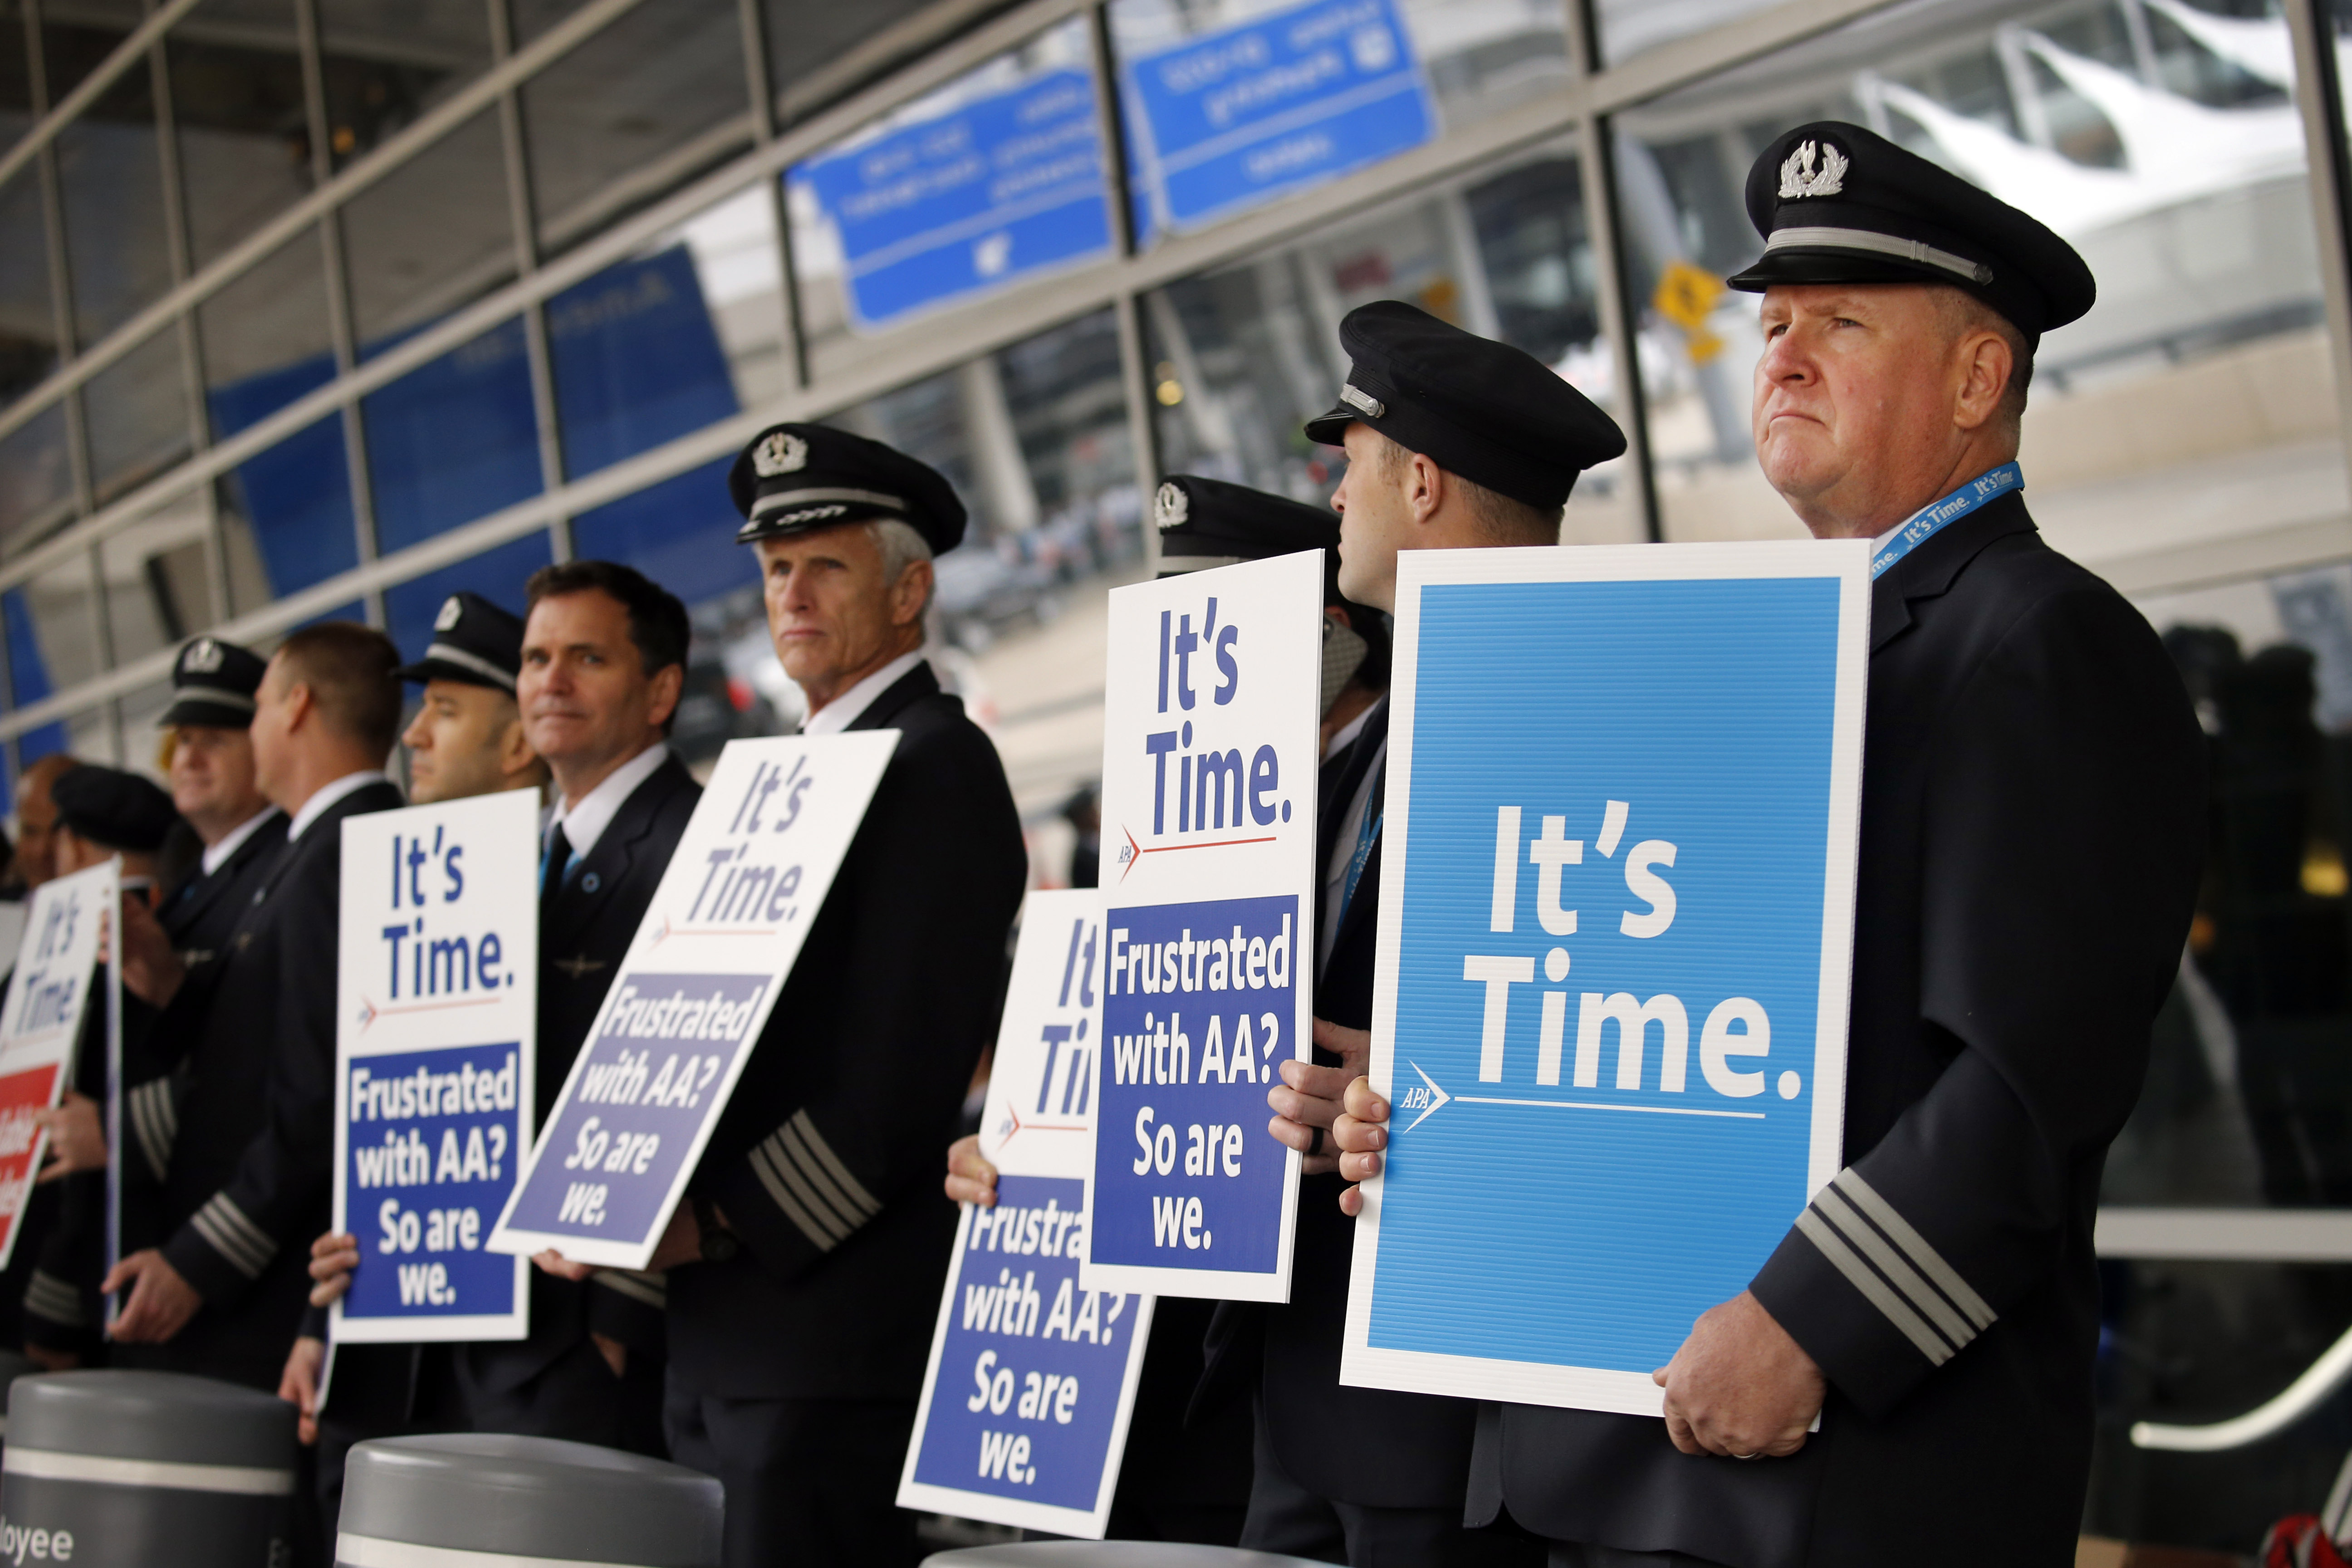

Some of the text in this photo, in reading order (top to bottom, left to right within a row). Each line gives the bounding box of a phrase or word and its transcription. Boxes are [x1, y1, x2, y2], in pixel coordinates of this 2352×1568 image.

[1973, 476, 1998, 495] It's
[1903, 497, 1970, 543] It's Time.
[1873, 552, 1899, 573] me.
[1157, 597, 1239, 713] It's
[729, 754, 814, 834] It's
[1146, 720, 1292, 835] Time.
[392, 825, 464, 909] It's
[686, 841, 803, 922] Time.
[1117, 845, 1132, 863] APA
[1490, 799, 1678, 938] It's
[382, 917, 514, 1000] Time.
[1109, 913, 1291, 995] Frustrated
[602, 985, 764, 1041] Frustrated
[1463, 947, 1801, 1100] Time.
[578, 1049, 720, 1109] with AA?
[1113, 1012, 1279, 1085] with AA?
[350, 1051, 516, 1122] Frustrated
[1399, 1087, 1431, 1109] APA
[355, 1123, 507, 1189] with AA?
[564, 1116, 660, 1175] So are
[1133, 1106, 1244, 1177] So are
[378, 1197, 480, 1255] So are
[558, 1182, 608, 1226] we.
[1152, 1195, 1212, 1250] we.
[397, 1262, 456, 1307] we.
[963, 1268, 1126, 1346] with AA?
[967, 1350, 1079, 1425] So are
[978, 1430, 1037, 1485] we.
